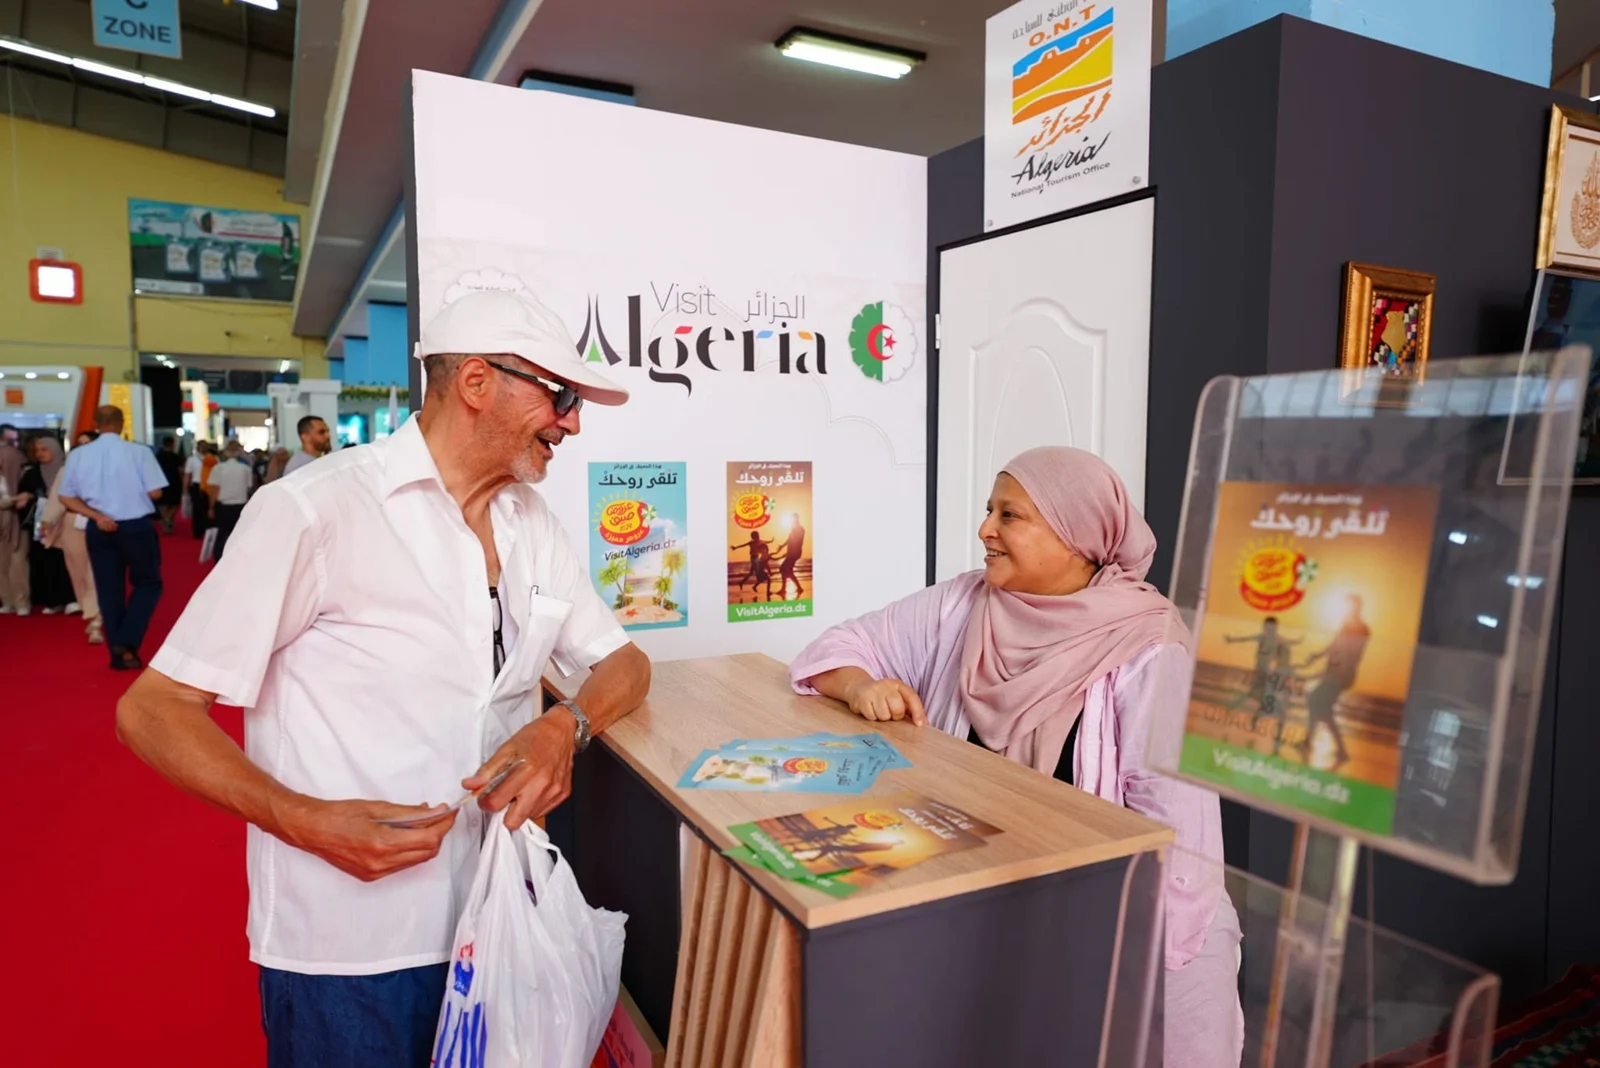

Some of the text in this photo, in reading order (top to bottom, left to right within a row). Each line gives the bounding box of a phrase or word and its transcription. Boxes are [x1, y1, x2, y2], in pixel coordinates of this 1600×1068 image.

[103, 15, 173, 44] ZONE
[1028, 3, 1096, 47] O.N.T
[1011, 130, 1112, 194] Algeria
[1011, 161, 1111, 198] National Tourism Office
[650, 280, 718, 317] Visit
[742, 290, 807, 325] الجزائر
[575, 291, 828, 399] Algeria
[598, 471, 678, 489] تلقى روحك
[604, 539, 677, 562] VisitAlgeria.dz
[735, 602, 807, 618] VisitAlgeria.dz
